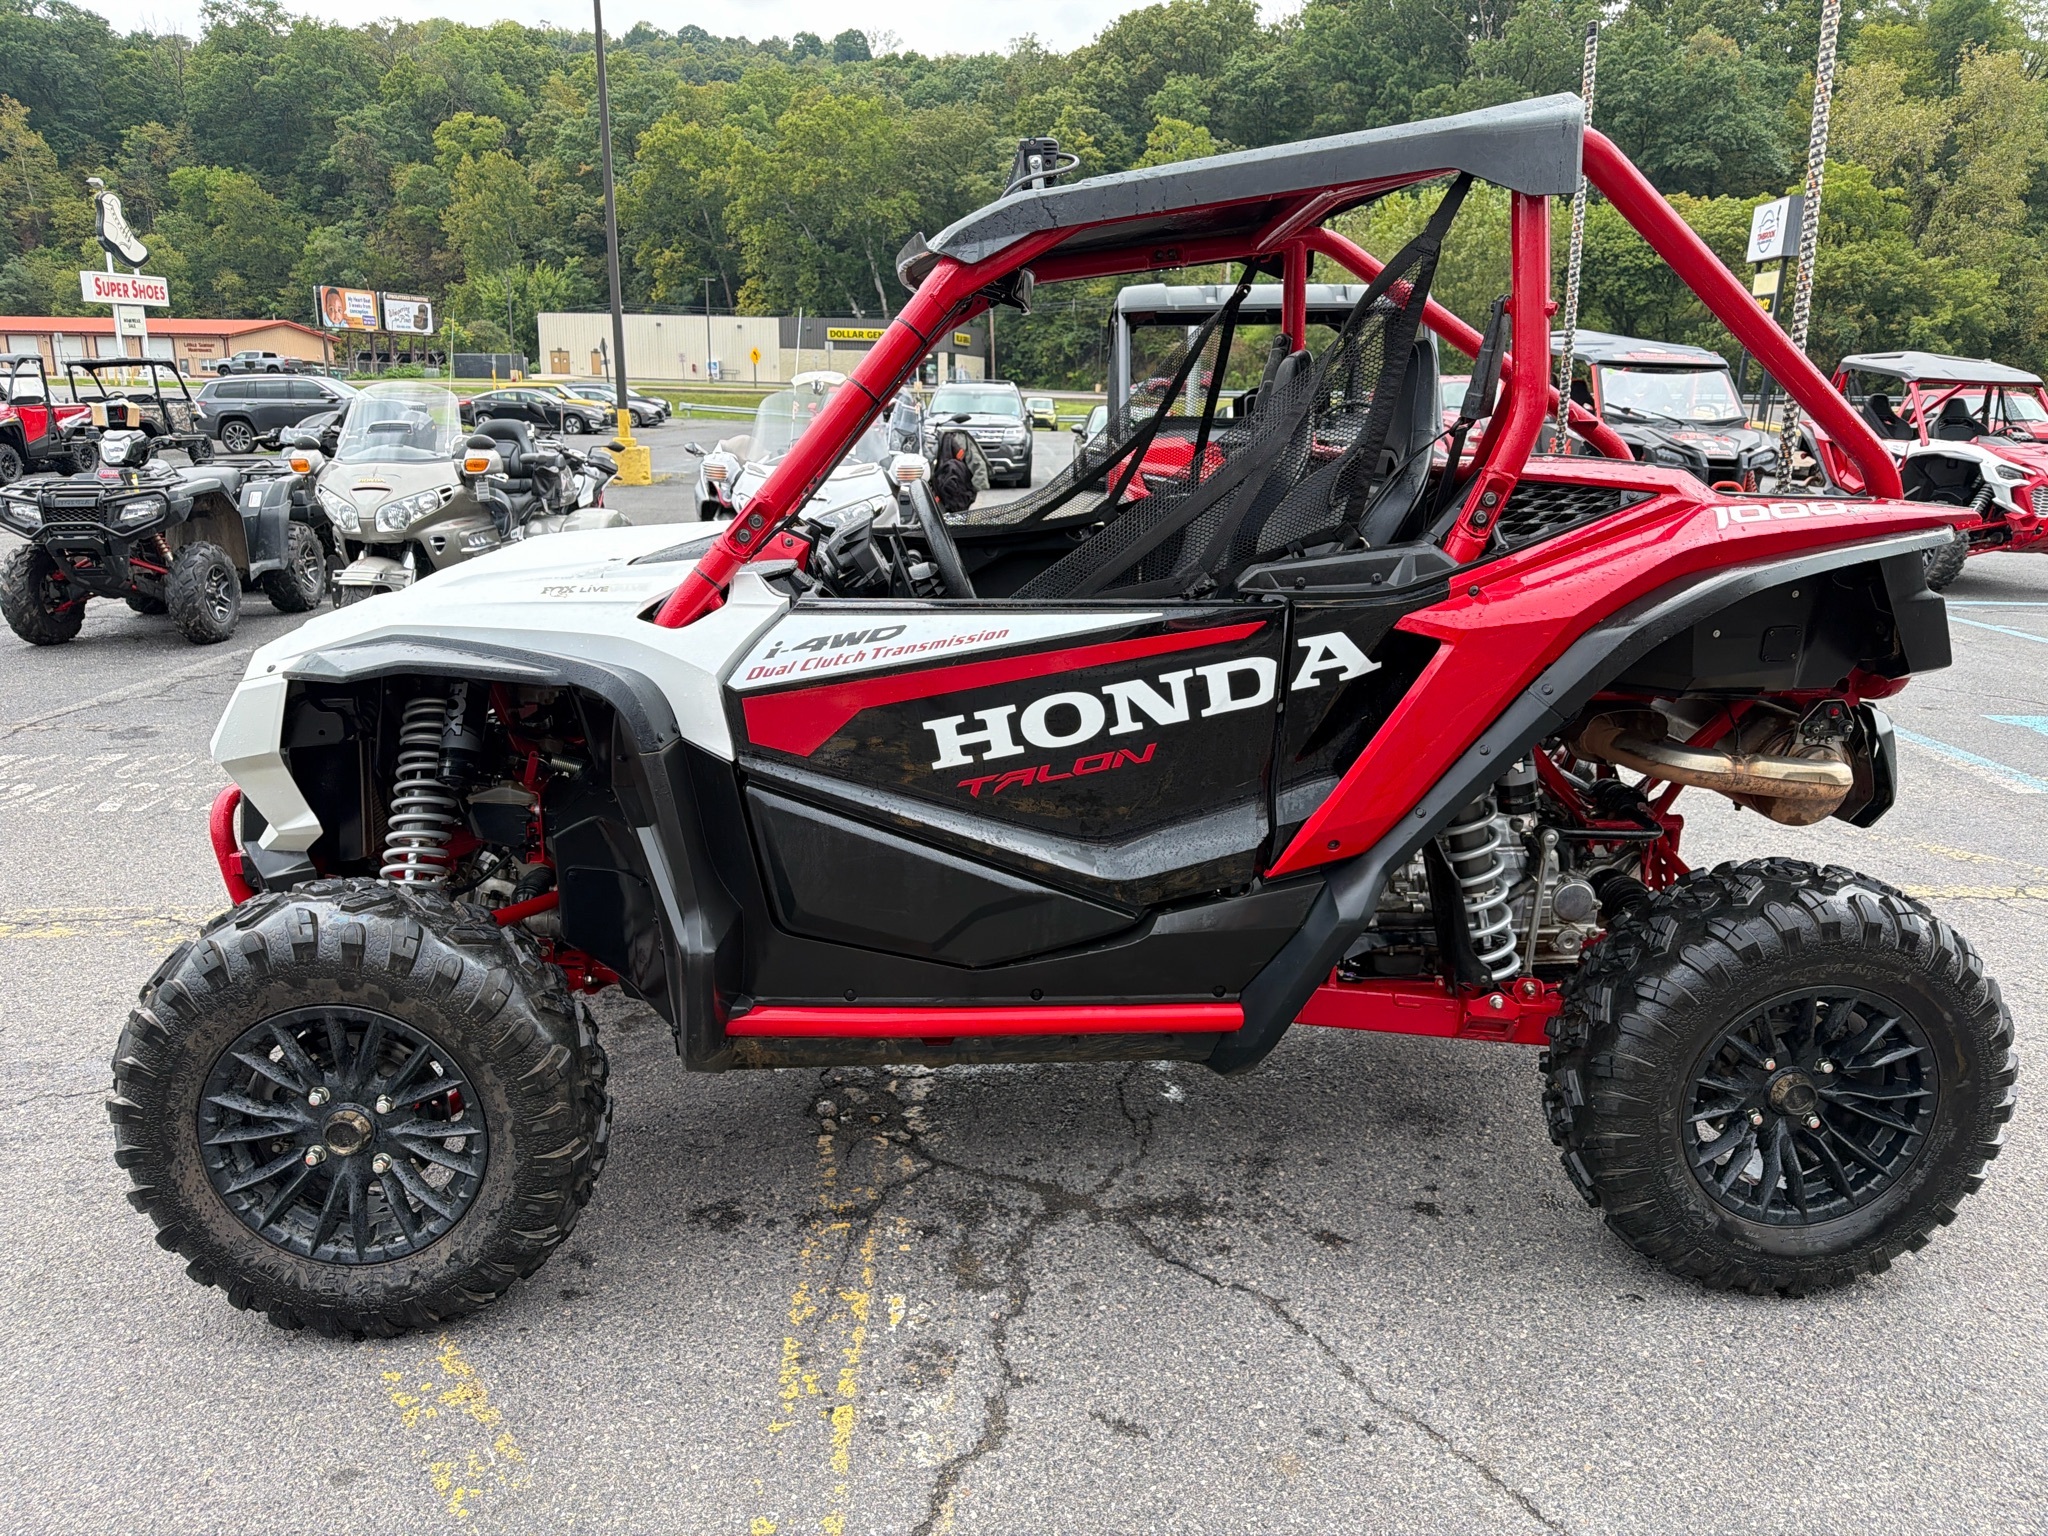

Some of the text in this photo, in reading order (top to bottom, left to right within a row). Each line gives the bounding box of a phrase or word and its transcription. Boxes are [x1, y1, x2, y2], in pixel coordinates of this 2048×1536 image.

[95, 277, 166, 301] SUPER SHOES
[829, 330, 864, 339] DOLLAR
[1710, 501, 1848, 532] 1000
[746, 629, 1010, 681] Dual Clutch Transmission
[923, 631, 1382, 770] HONDA
[956, 742, 1158, 798] TALON
